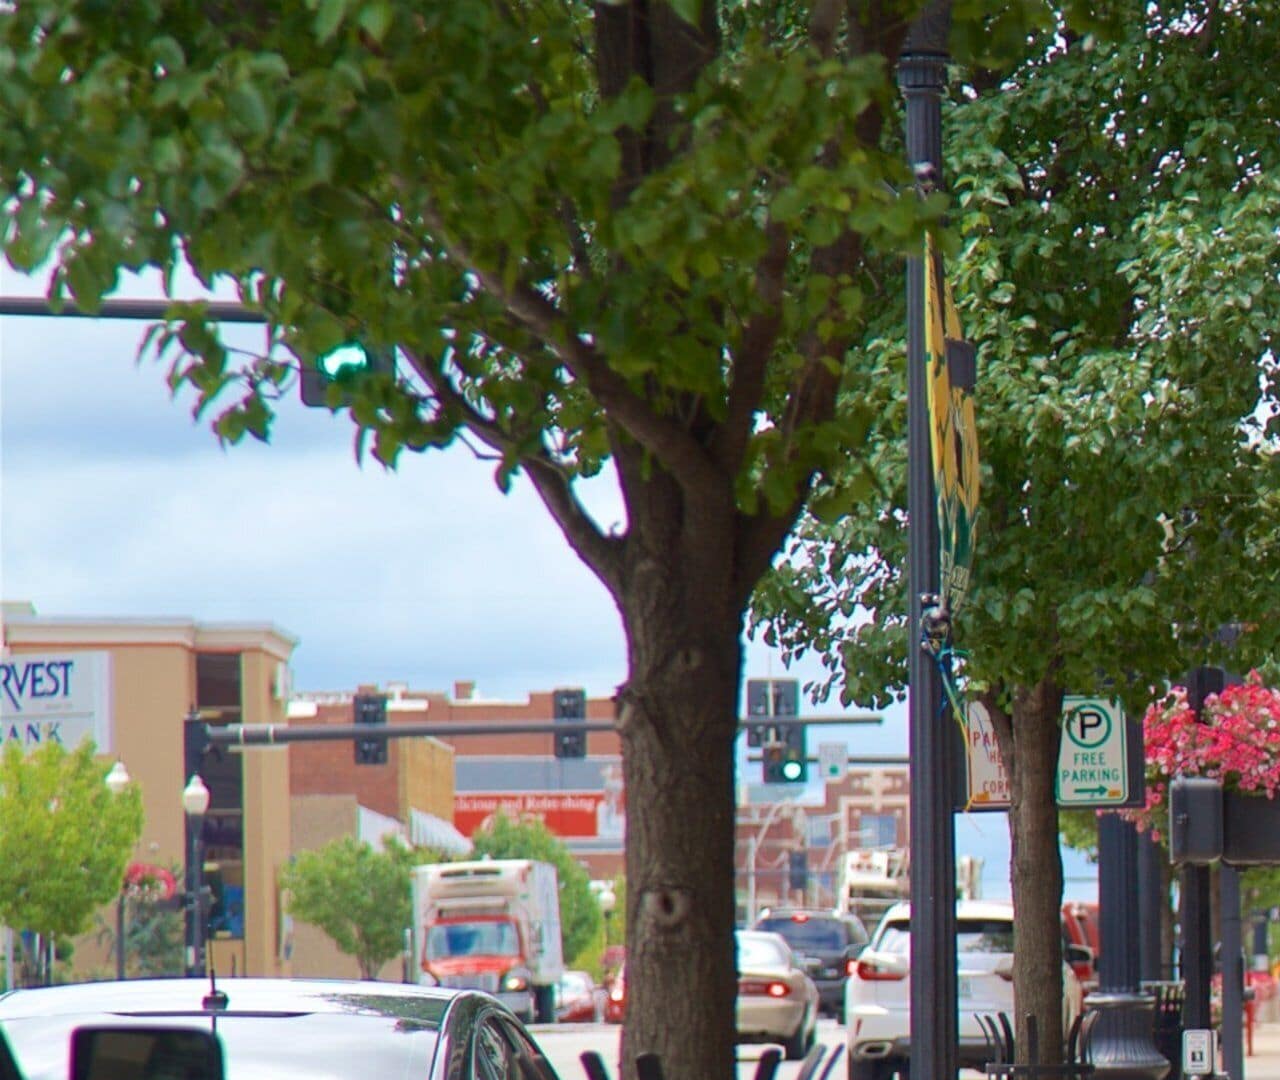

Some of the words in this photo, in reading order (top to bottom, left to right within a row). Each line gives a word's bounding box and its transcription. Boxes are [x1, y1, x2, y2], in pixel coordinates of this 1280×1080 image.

[0, 721, 62, 745] ANK
[1079, 711, 1102, 739] P
[1073, 752, 1107, 766] FREE
[1061, 767, 1121, 782] PARKING
